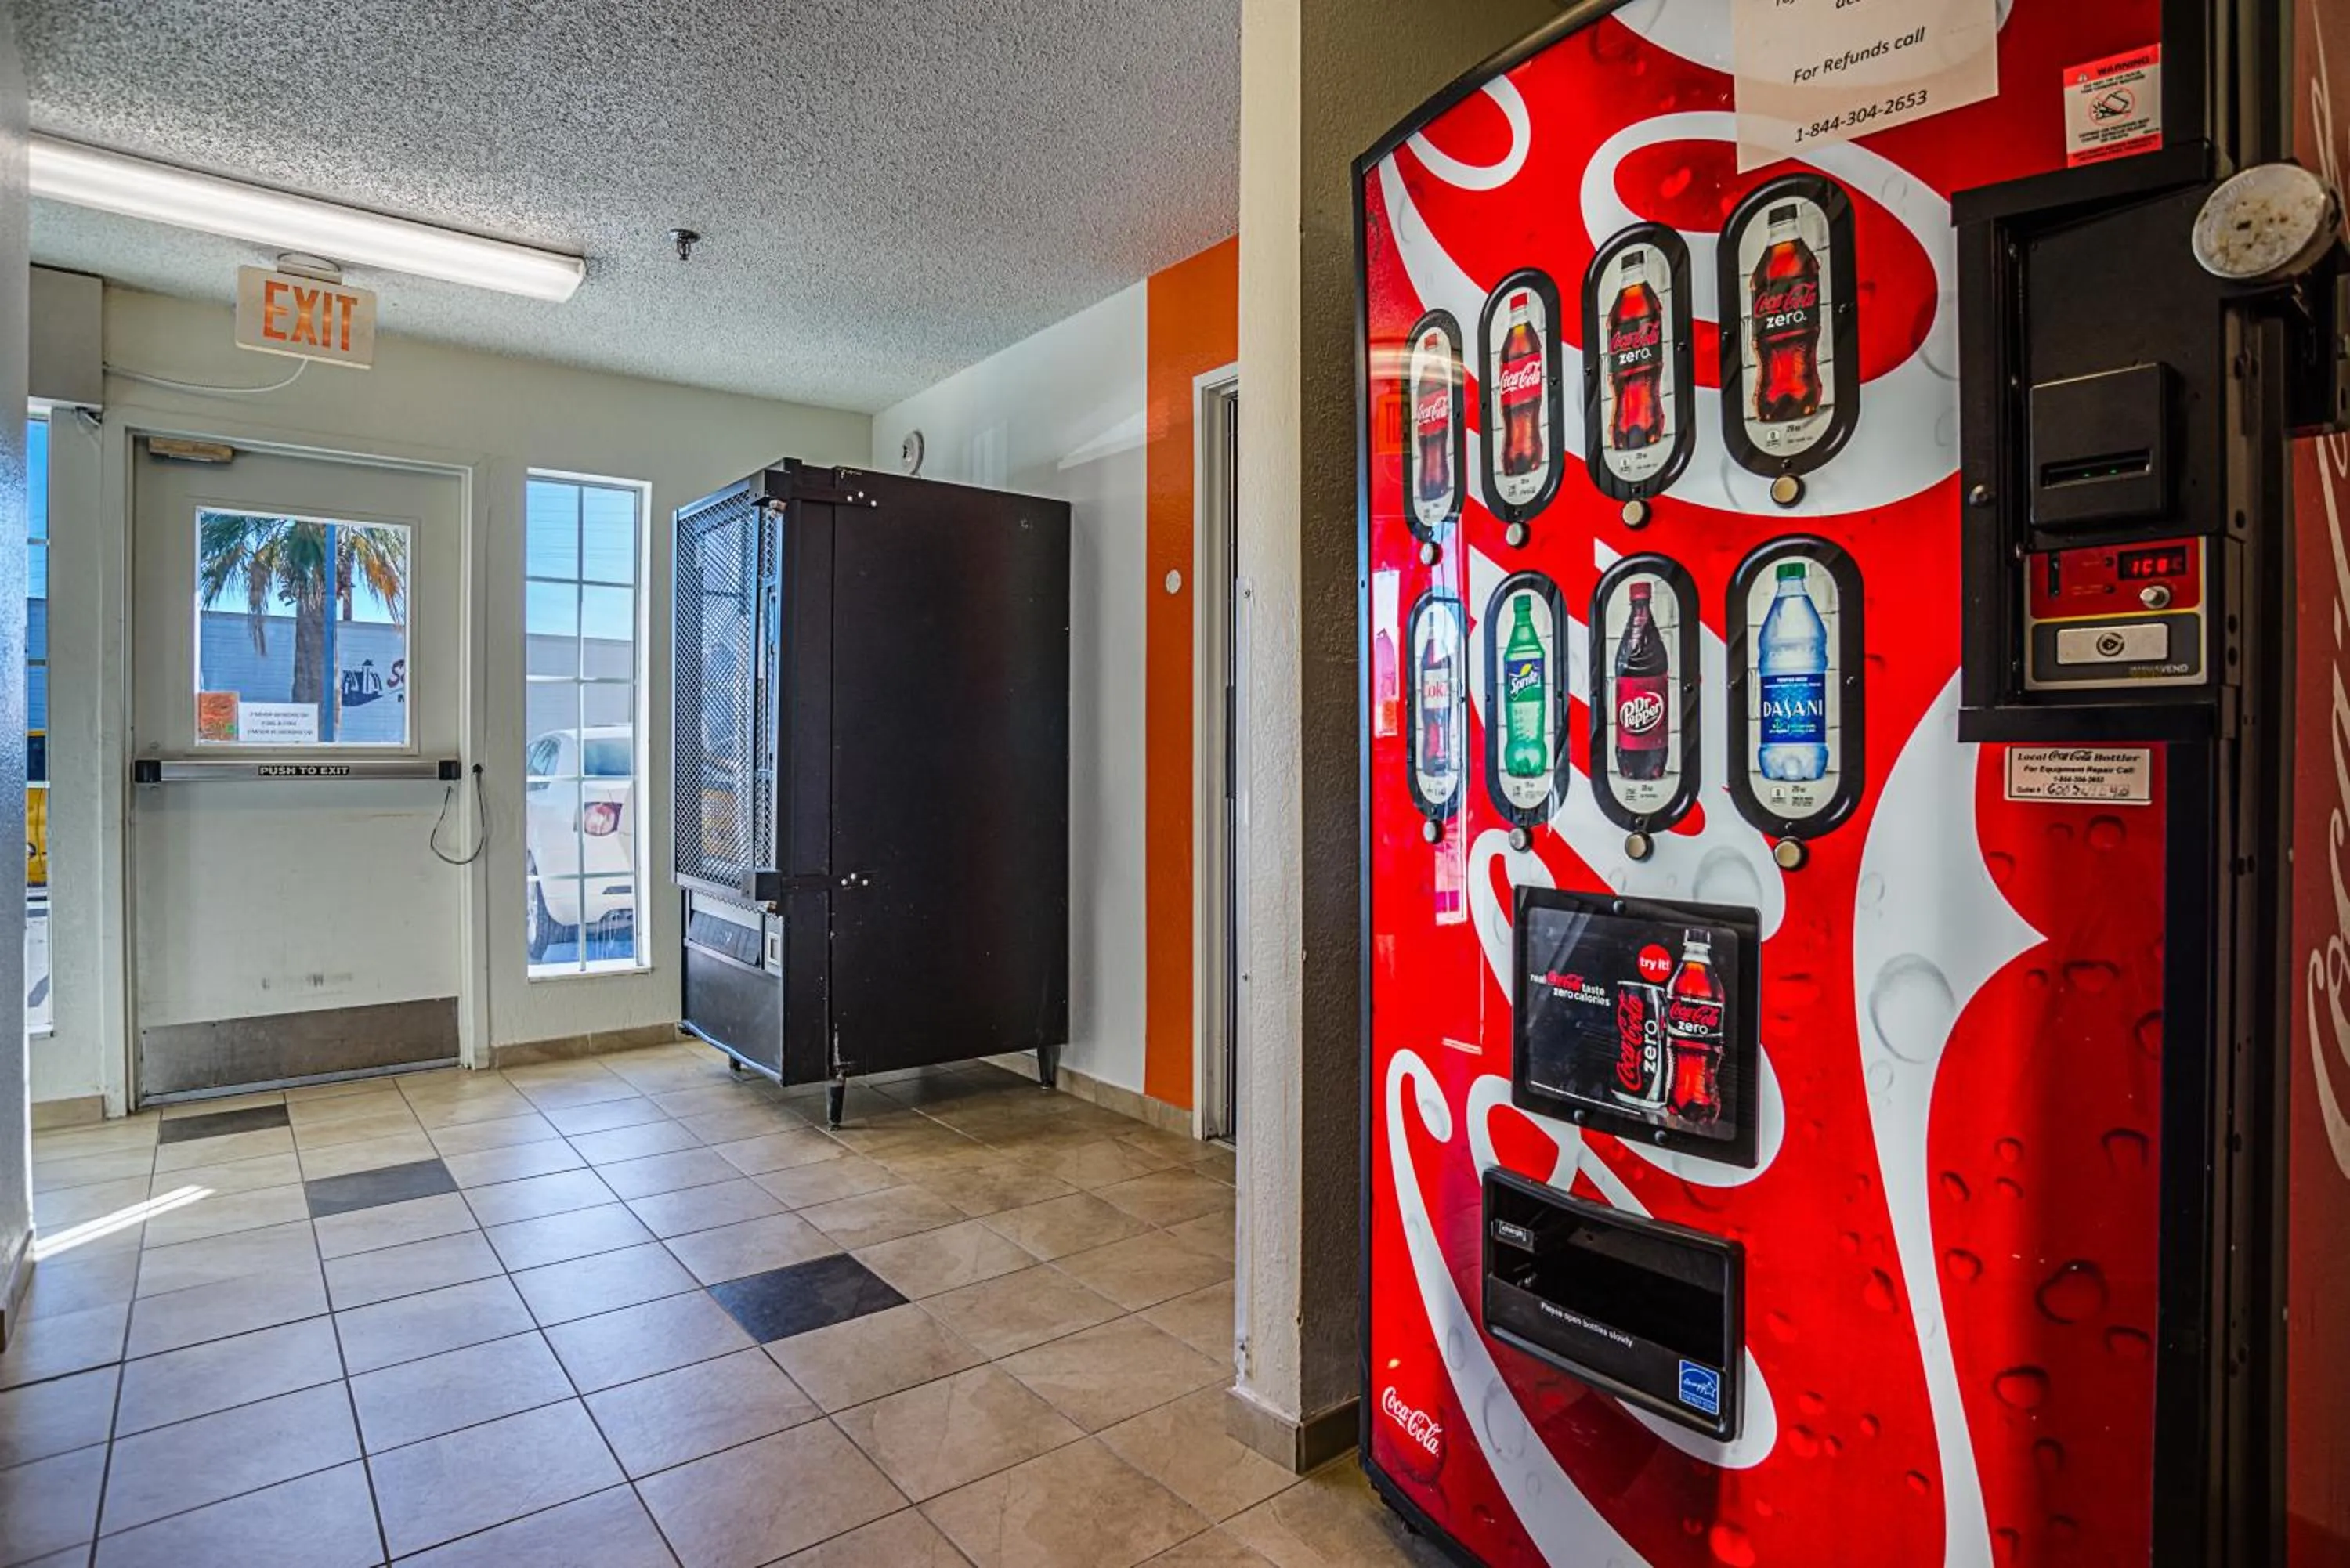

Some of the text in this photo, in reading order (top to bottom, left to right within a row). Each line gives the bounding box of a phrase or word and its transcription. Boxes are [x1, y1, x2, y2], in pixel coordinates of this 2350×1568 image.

[1793, 26, 1925, 85] For Refunds call
[2096, 56, 2150, 76] WARNING
[1795, 89, 1928, 143] 1-844-304-2653
[263, 280, 358, 352] EXIT
[1509, 671, 1539, 695] Sprite
[1623, 701, 1661, 729] Pepper
[1634, 696, 1652, 713] Dr
[1763, 695, 1823, 719] DASANI
[2018, 753, 2046, 761] Local
[2094, 753, 2141, 762] Bottler
[1640, 956, 1672, 971] try it!
[1530, 974, 1547, 985] real
[1582, 983, 1605, 995] taste
[1553, 988, 1611, 1006] zero calories
[1677, 1021, 1708, 1035] zero
[1644, 1020, 1658, 1075] zero
[1540, 1301, 1633, 1349] Please open bottles slowly
